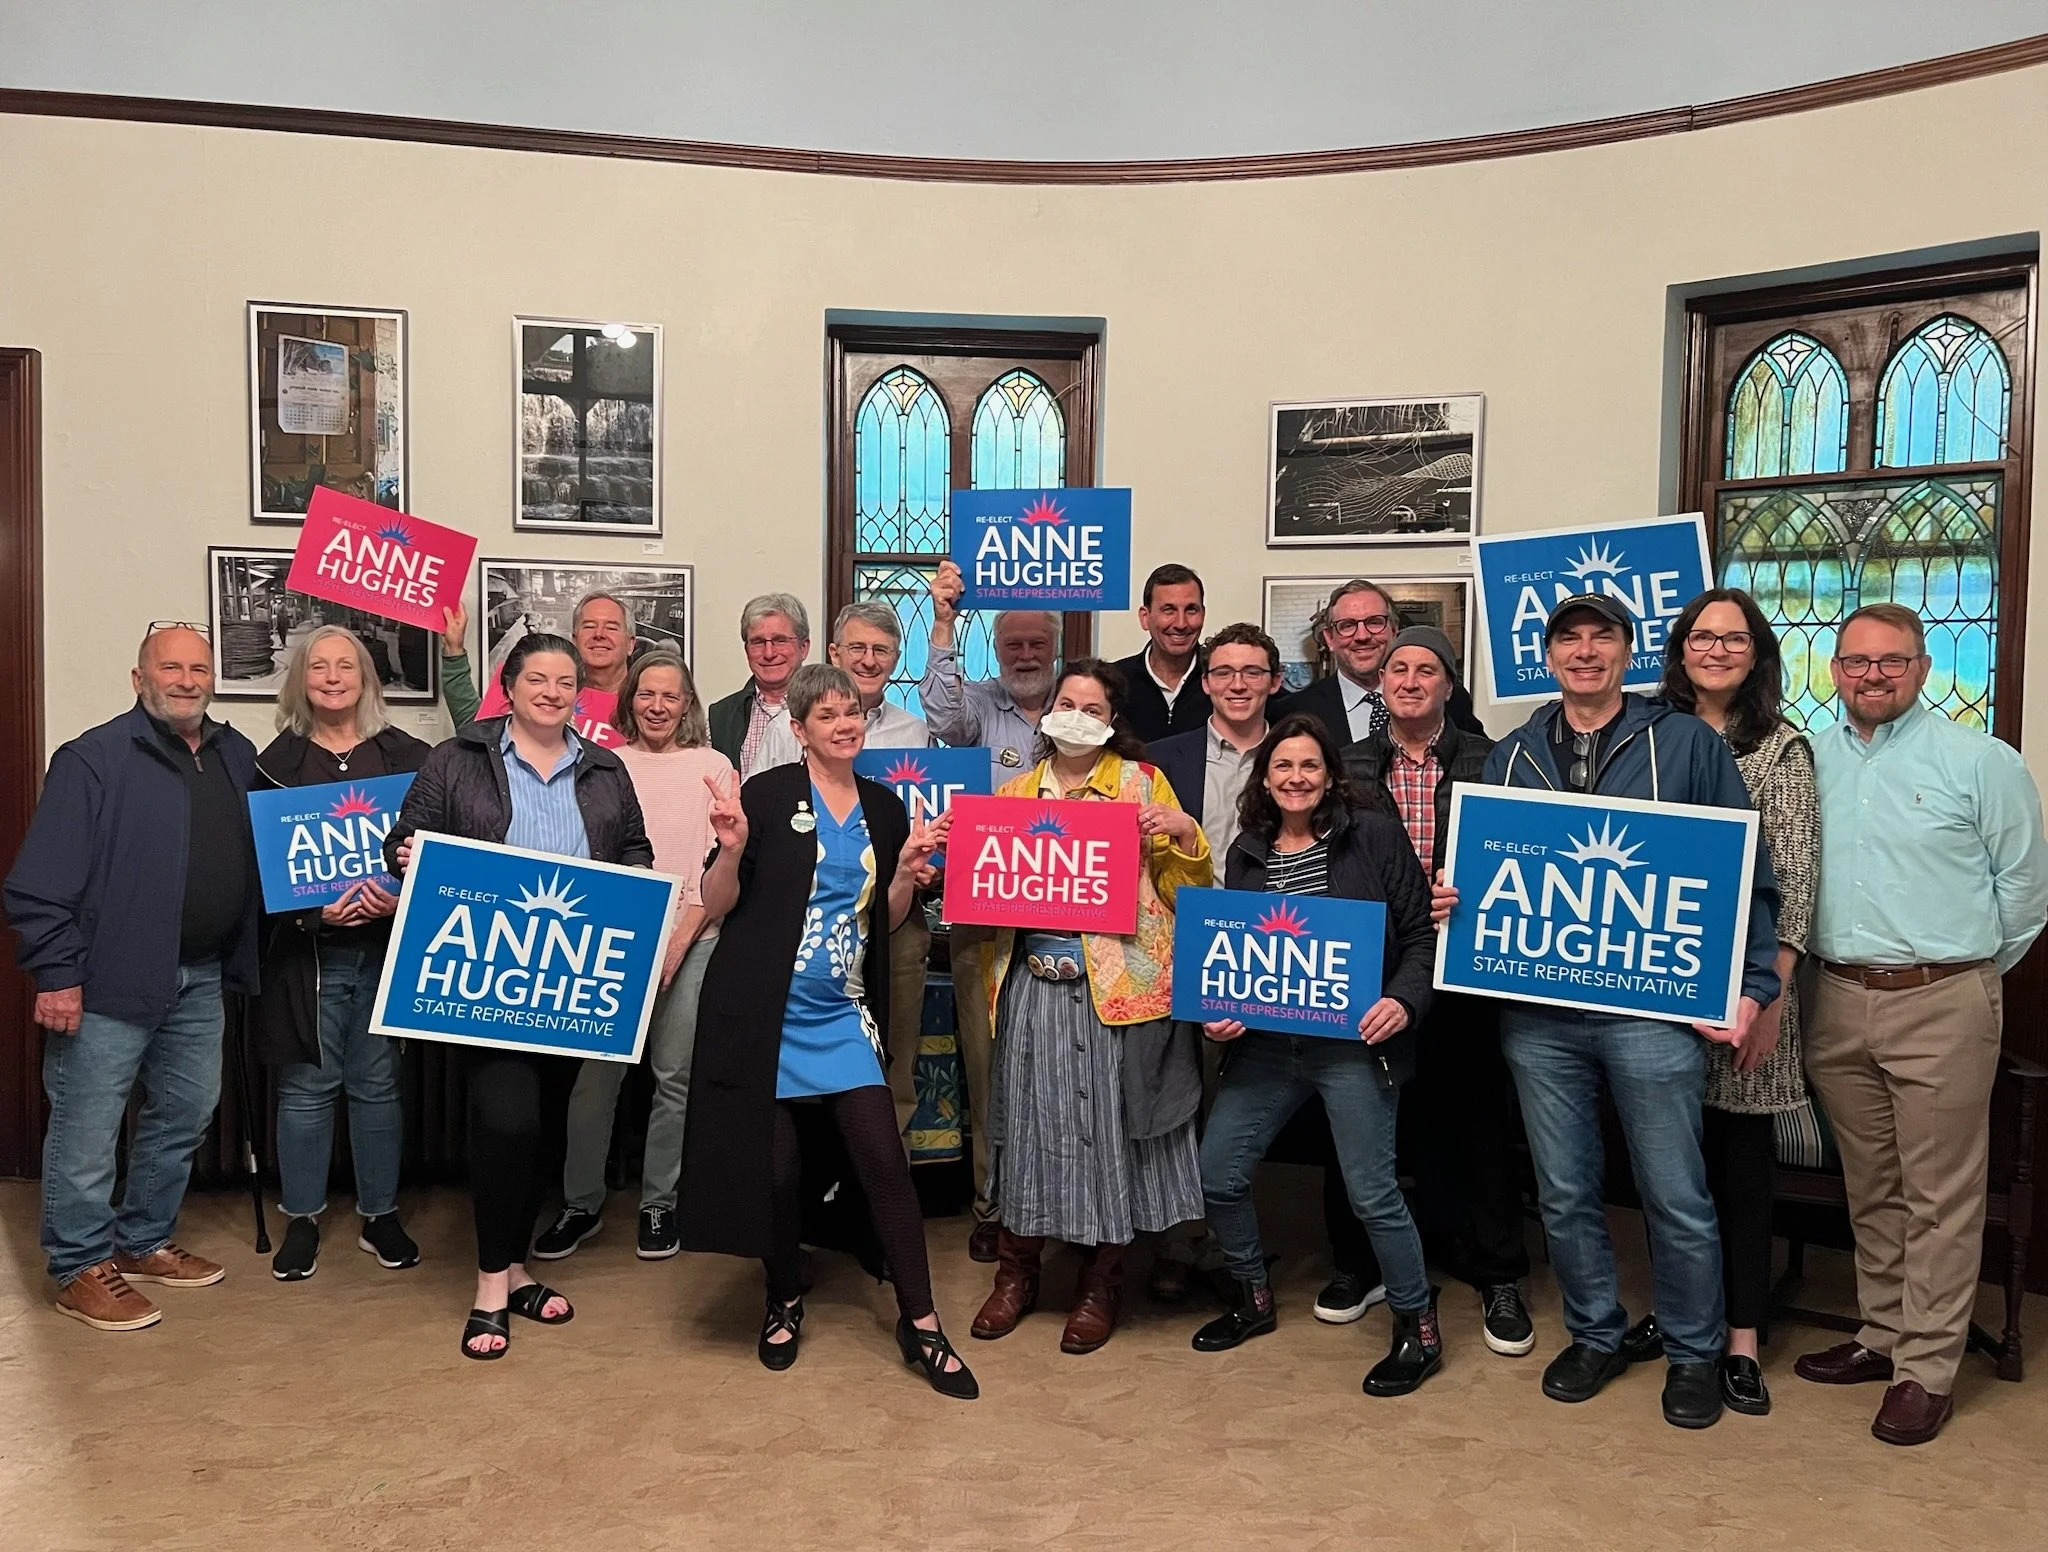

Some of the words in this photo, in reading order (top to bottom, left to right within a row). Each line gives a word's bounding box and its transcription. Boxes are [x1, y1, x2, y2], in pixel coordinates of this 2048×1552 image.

[331, 516, 367, 531] RE-ELECT
[976, 516, 1013, 524] RE-ELECT
[323, 528, 445, 588] ANNE
[975, 525, 1104, 561] ANNE
[316, 554, 436, 608] HUGHES
[975, 561, 1104, 587] HUGHES
[1504, 571, 1554, 584] RE-ELECT
[976, 588, 1009, 598] STATE
[1011, 588, 1103, 599] REPRESENTATIVE
[281, 812, 321, 823] RE-ELECT
[287, 811, 401, 860] ANN
[975, 824, 1015, 834] RE-ELECT
[973, 835, 1110, 878] ANNE
[1484, 839, 1547, 856] RE-ELECT
[287, 849, 389, 885] HUGH
[293, 883, 328, 897] STATE
[438, 886, 499, 904] RE-ELECT
[971, 872, 1109, 905] HUGHES
[1478, 858, 1709, 936] ANNE
[425, 904, 635, 981] ANNE
[1204, 919, 1246, 930] RE-ELECT
[1202, 930, 1351, 982] ANNE
[1474, 912, 1703, 978] HUGHES
[416, 956, 623, 1018] HUGHES
[1201, 968, 1350, 1011] HUGHES
[1473, 956, 1529, 978] STATE
[1534, 964, 1698, 999] REPRESENTATIVE
[413, 998, 467, 1019] STATE
[471, 1005, 615, 1037] REPRESENTATIVE
[1201, 999, 1238, 1013] STATE
[1241, 1004, 1349, 1025] REPRESENTATIVE
